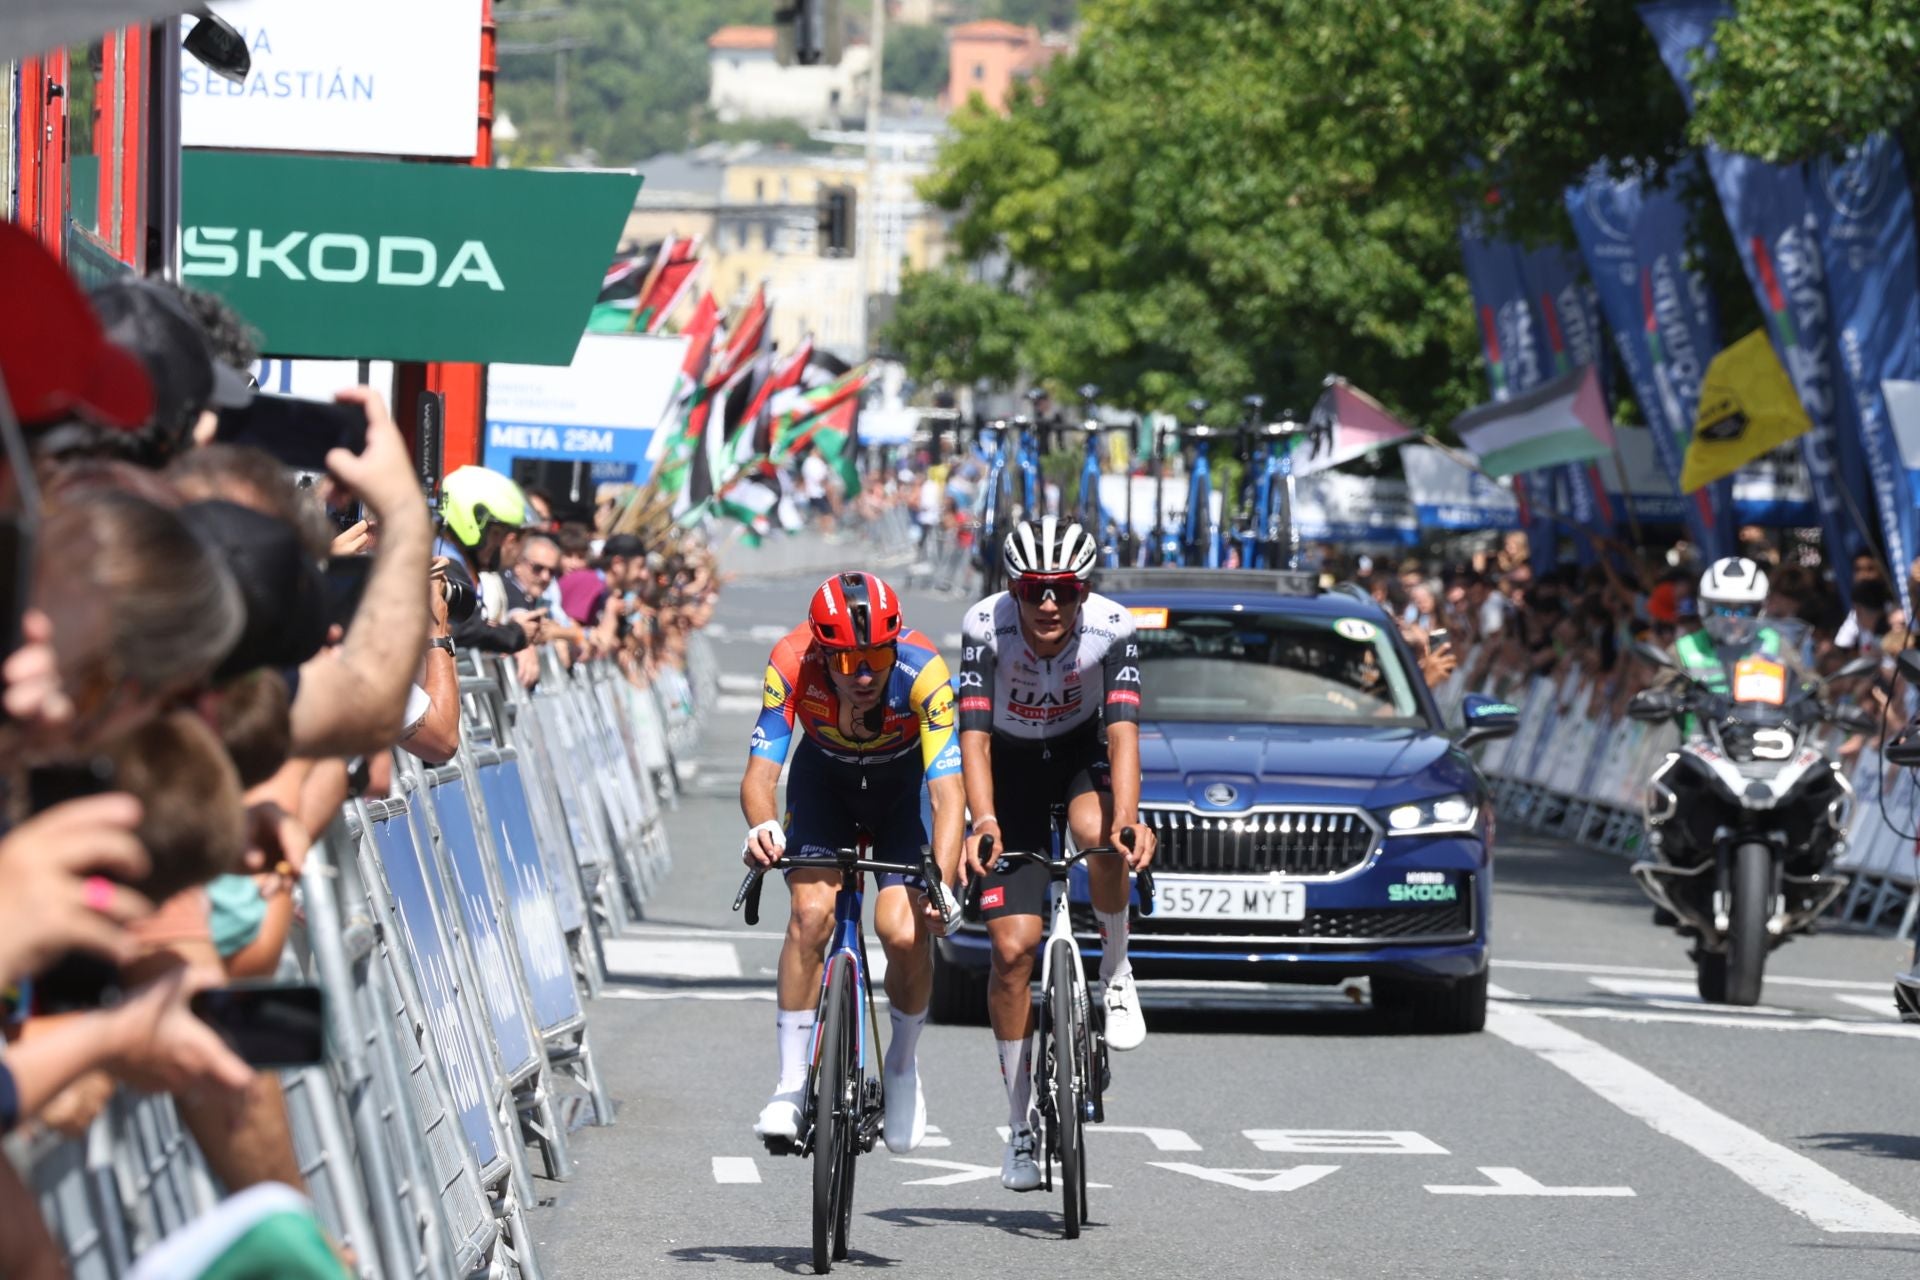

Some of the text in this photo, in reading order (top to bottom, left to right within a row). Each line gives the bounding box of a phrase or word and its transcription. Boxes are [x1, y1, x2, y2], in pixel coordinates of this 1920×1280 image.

[179, 67, 374, 100] SEBASTIÁN
[490, 424, 614, 453] META 25M
[821, 581, 838, 616] TREK
[895, 660, 918, 679] TREK
[1009, 688, 1081, 706] UAE
[1162, 887, 1294, 915] 5572 MYT
[1388, 883, 1457, 901] SKODA
